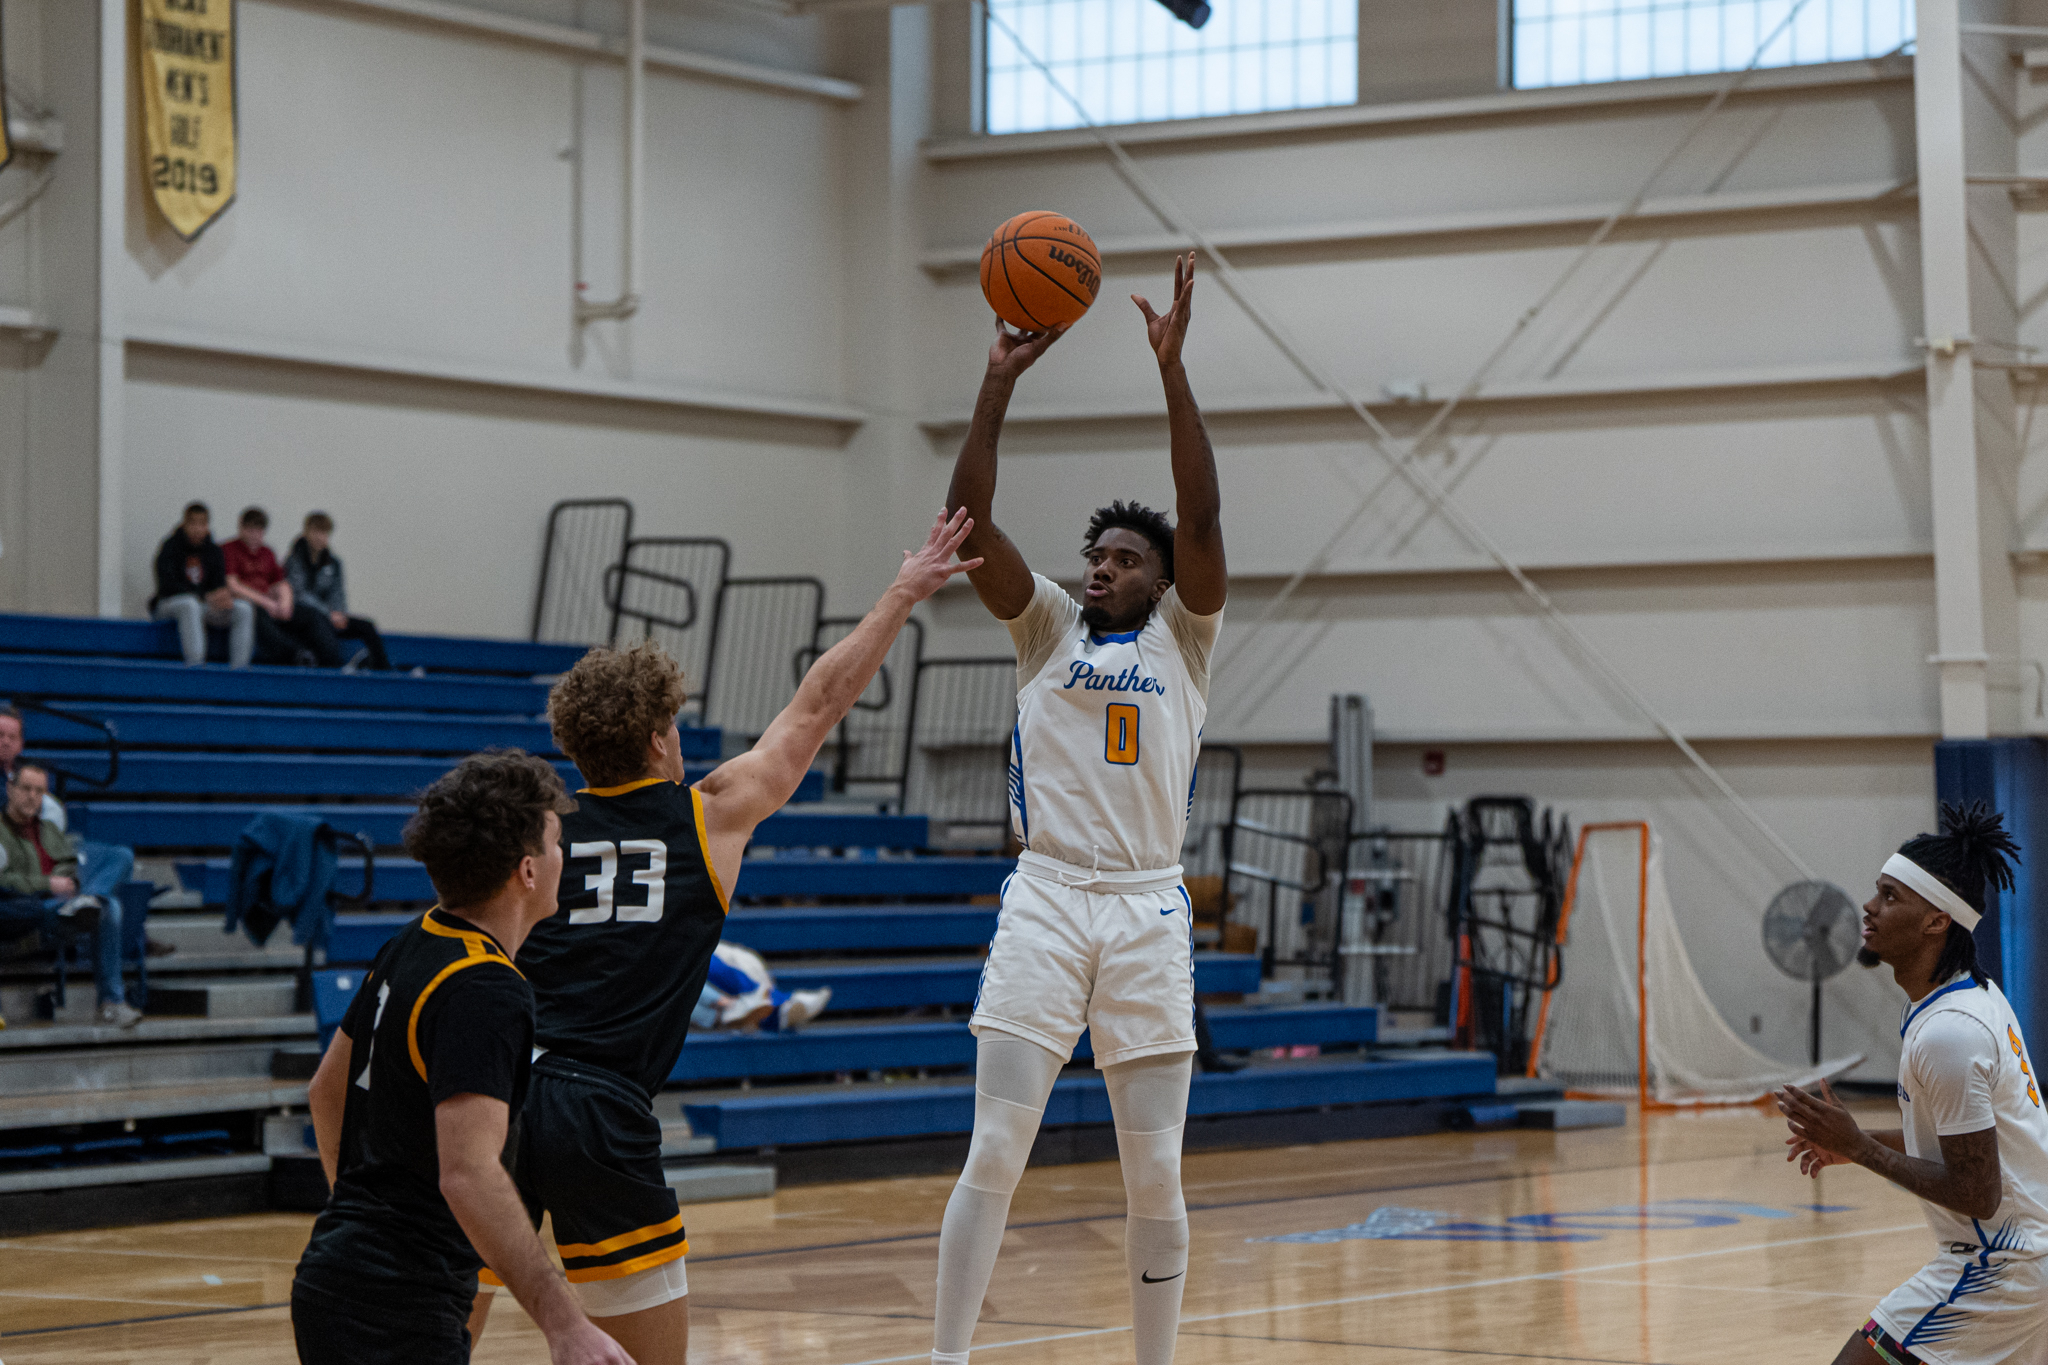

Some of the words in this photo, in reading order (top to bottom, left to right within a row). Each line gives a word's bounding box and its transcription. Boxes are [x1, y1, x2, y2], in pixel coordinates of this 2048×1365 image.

[152, 153, 218, 196] 2019
[1048, 245, 1101, 299] Wilson
[1104, 702, 1140, 766] 0
[569, 839, 667, 924] 33
